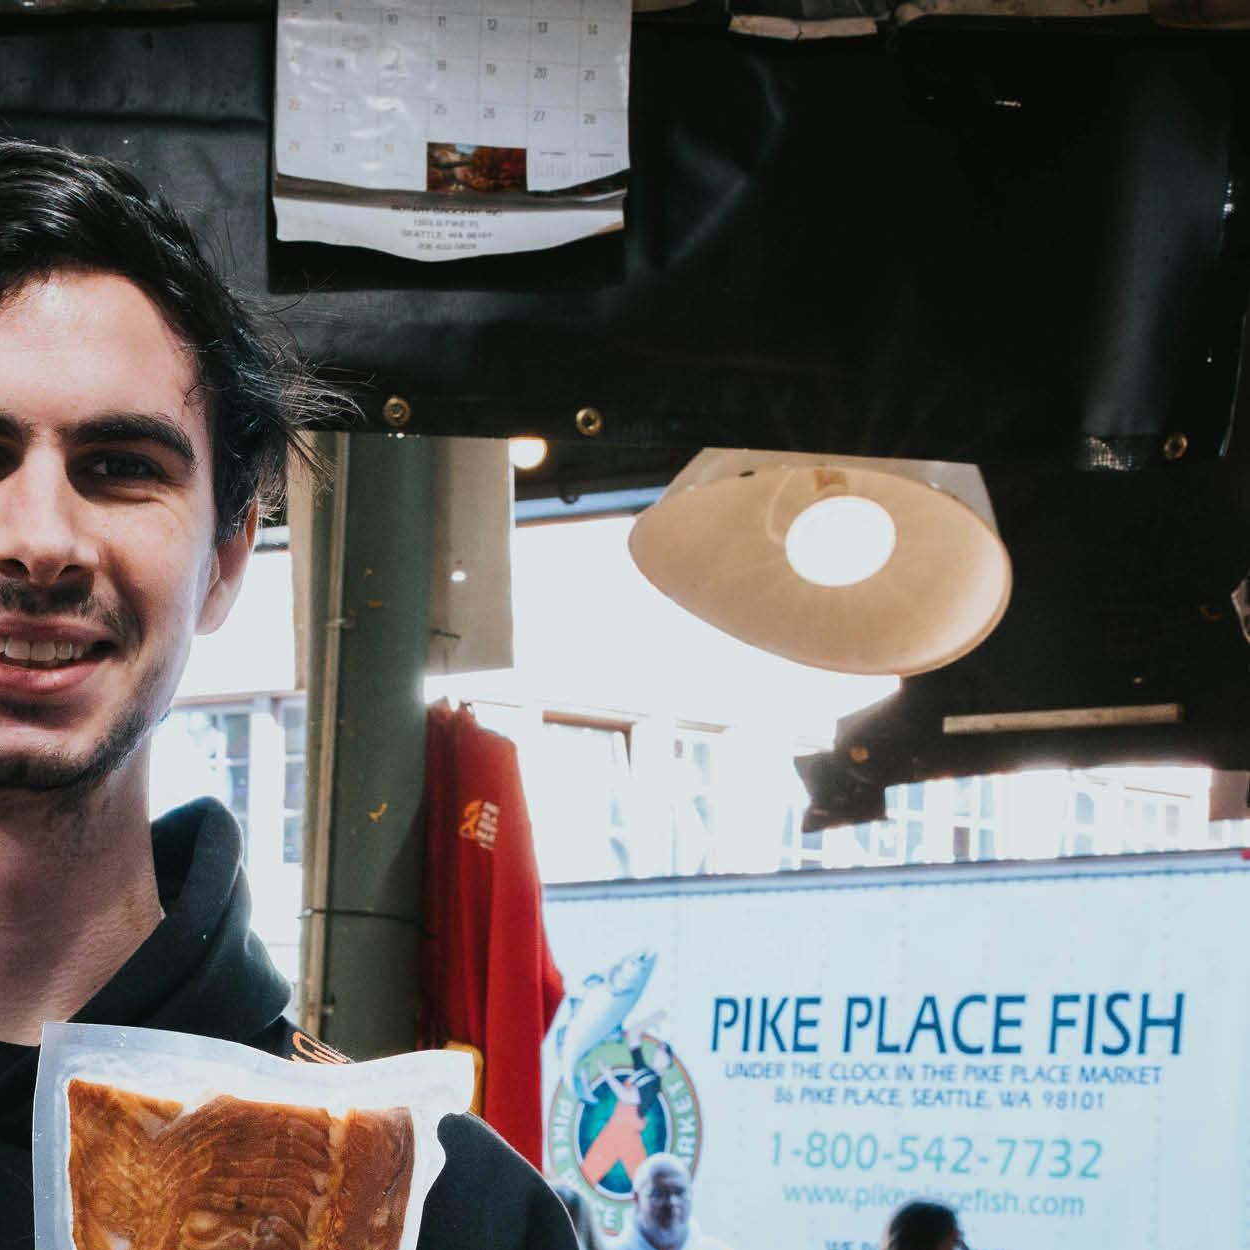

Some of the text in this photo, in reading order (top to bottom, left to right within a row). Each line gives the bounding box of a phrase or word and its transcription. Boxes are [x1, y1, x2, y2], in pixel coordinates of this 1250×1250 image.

[712, 992, 1184, 1056] PIKE PLACE FISH
[725, 1062, 1163, 1086] UNDER THE CLOCK IN THE PIKE PLACE MARKET
[800, 1087, 837, 1105] PIKE
[999, 1091, 1032, 1109] WA
[1042, 1091, 1105, 1110] 98101
[771, 1130, 1103, 1180] 1-800-542-7732
